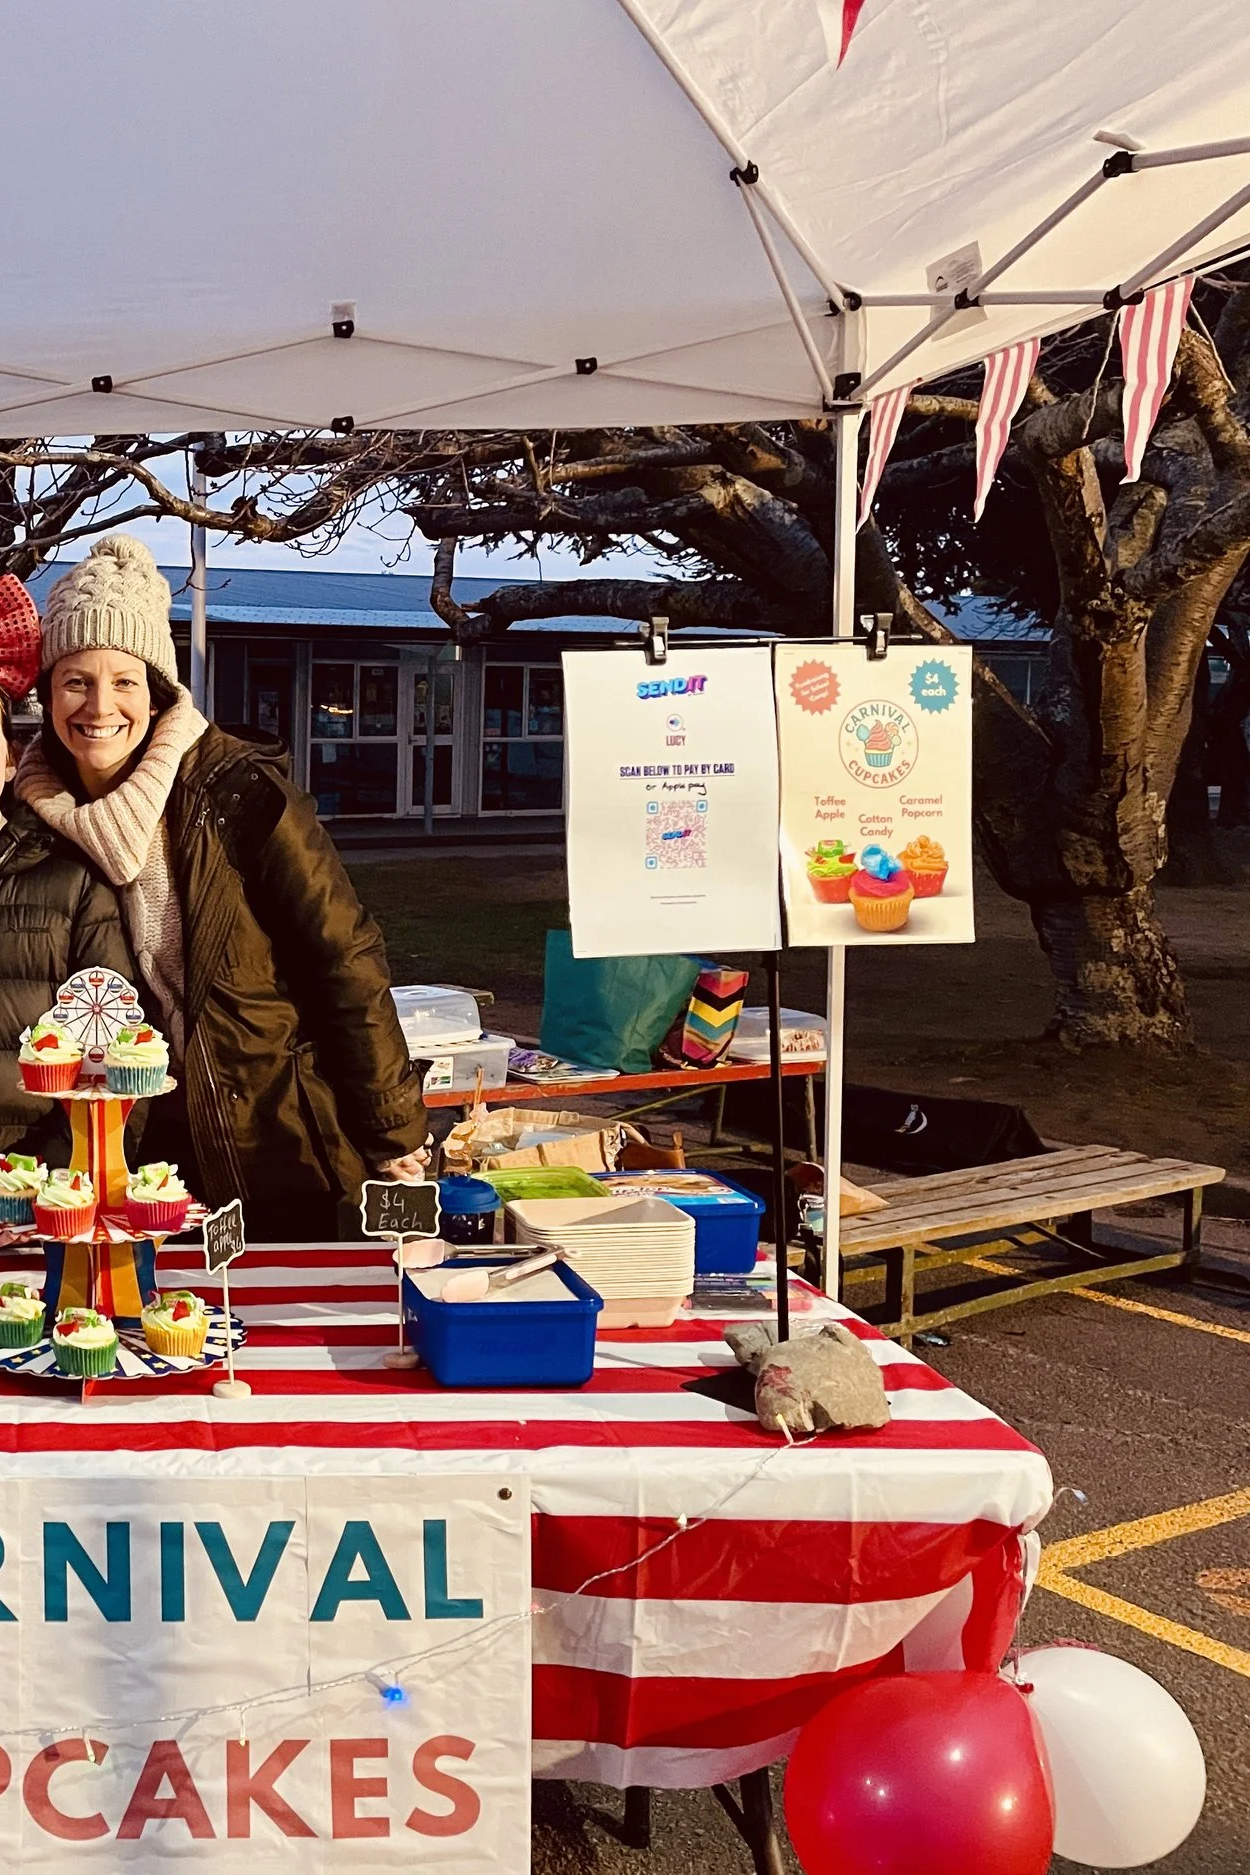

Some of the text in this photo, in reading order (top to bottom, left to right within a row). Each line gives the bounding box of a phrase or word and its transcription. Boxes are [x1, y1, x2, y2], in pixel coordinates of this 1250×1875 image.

[924, 671, 939, 685] $4
[636, 674, 709, 700] SENDIT
[921, 686, 947, 697] each
[844, 703, 911, 734] CARNIVAL
[665, 735, 687, 747] LUCY
[619, 763, 735, 777] SCAN BELOW TO PAY BY CARD
[848, 759, 911, 785] CUPCAKES
[645, 781, 708, 796] or Apple pay
[814, 795, 847, 806] Toffee
[899, 794, 944, 805] Caramel
[815, 808, 846, 821] Apple
[858, 813, 893, 824] Cotton
[901, 807, 944, 819] Popcorn
[860, 826, 894, 838] Candy
[379, 1188, 405, 1214] $4
[208, 1213, 237, 1241] Toffee
[378, 1211, 423, 1230] Each
[230, 1236, 242, 1255] $4
